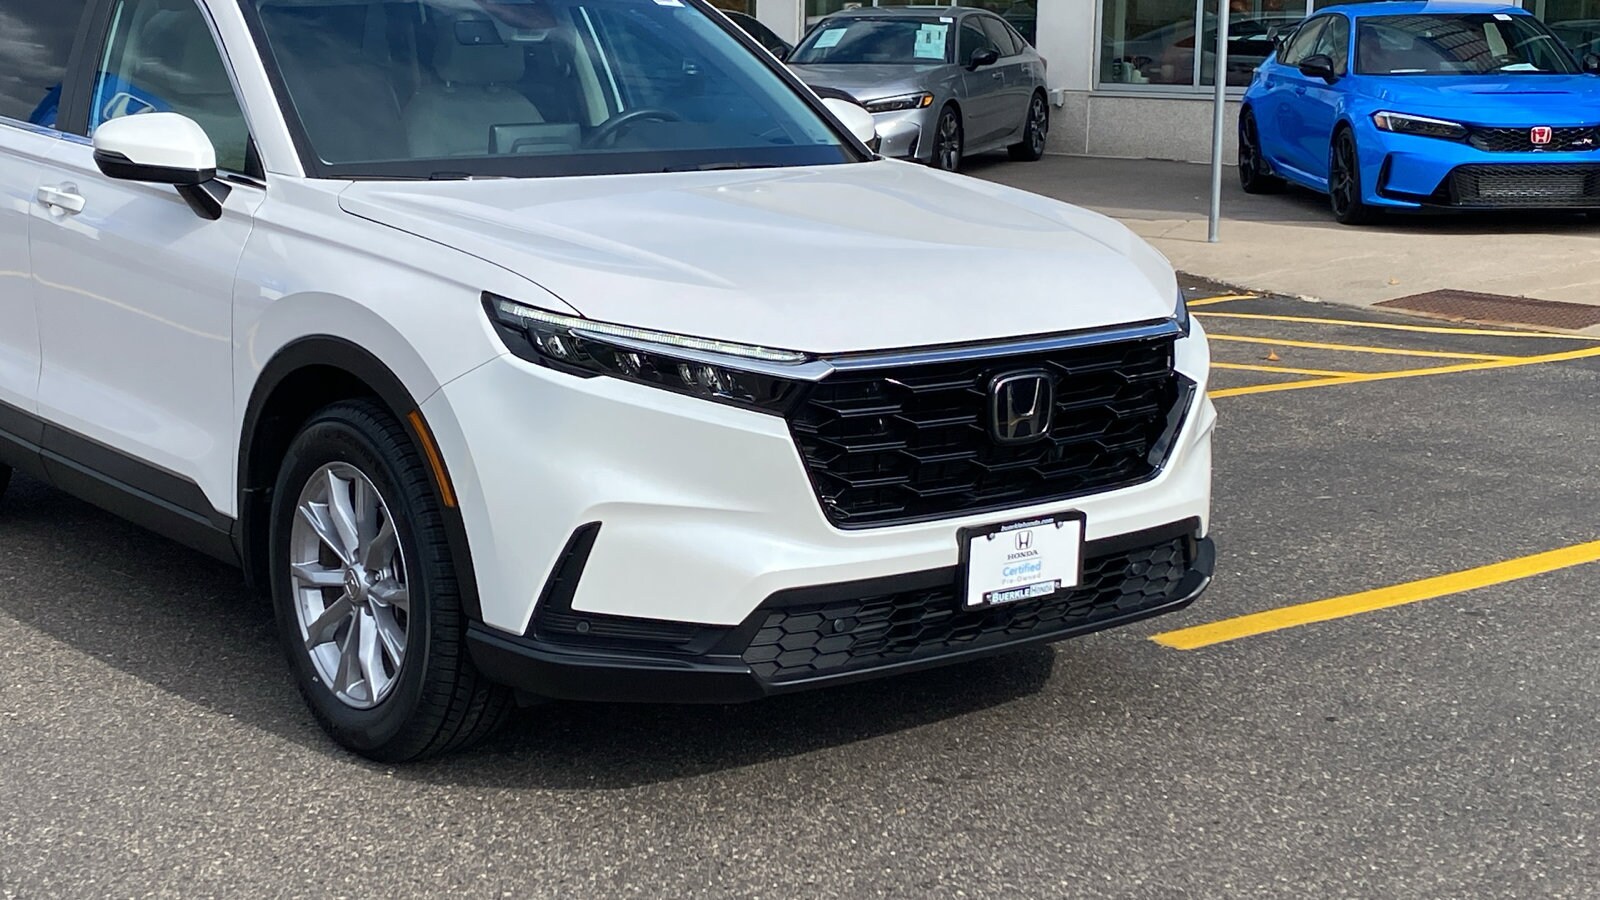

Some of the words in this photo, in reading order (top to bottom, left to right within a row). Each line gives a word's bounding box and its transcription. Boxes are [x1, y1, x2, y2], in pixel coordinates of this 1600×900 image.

[1007, 550, 1039, 560] HONDA
[1002, 561, 1041, 577] Certified
[1002, 573, 1041, 585] Pre-Owned
